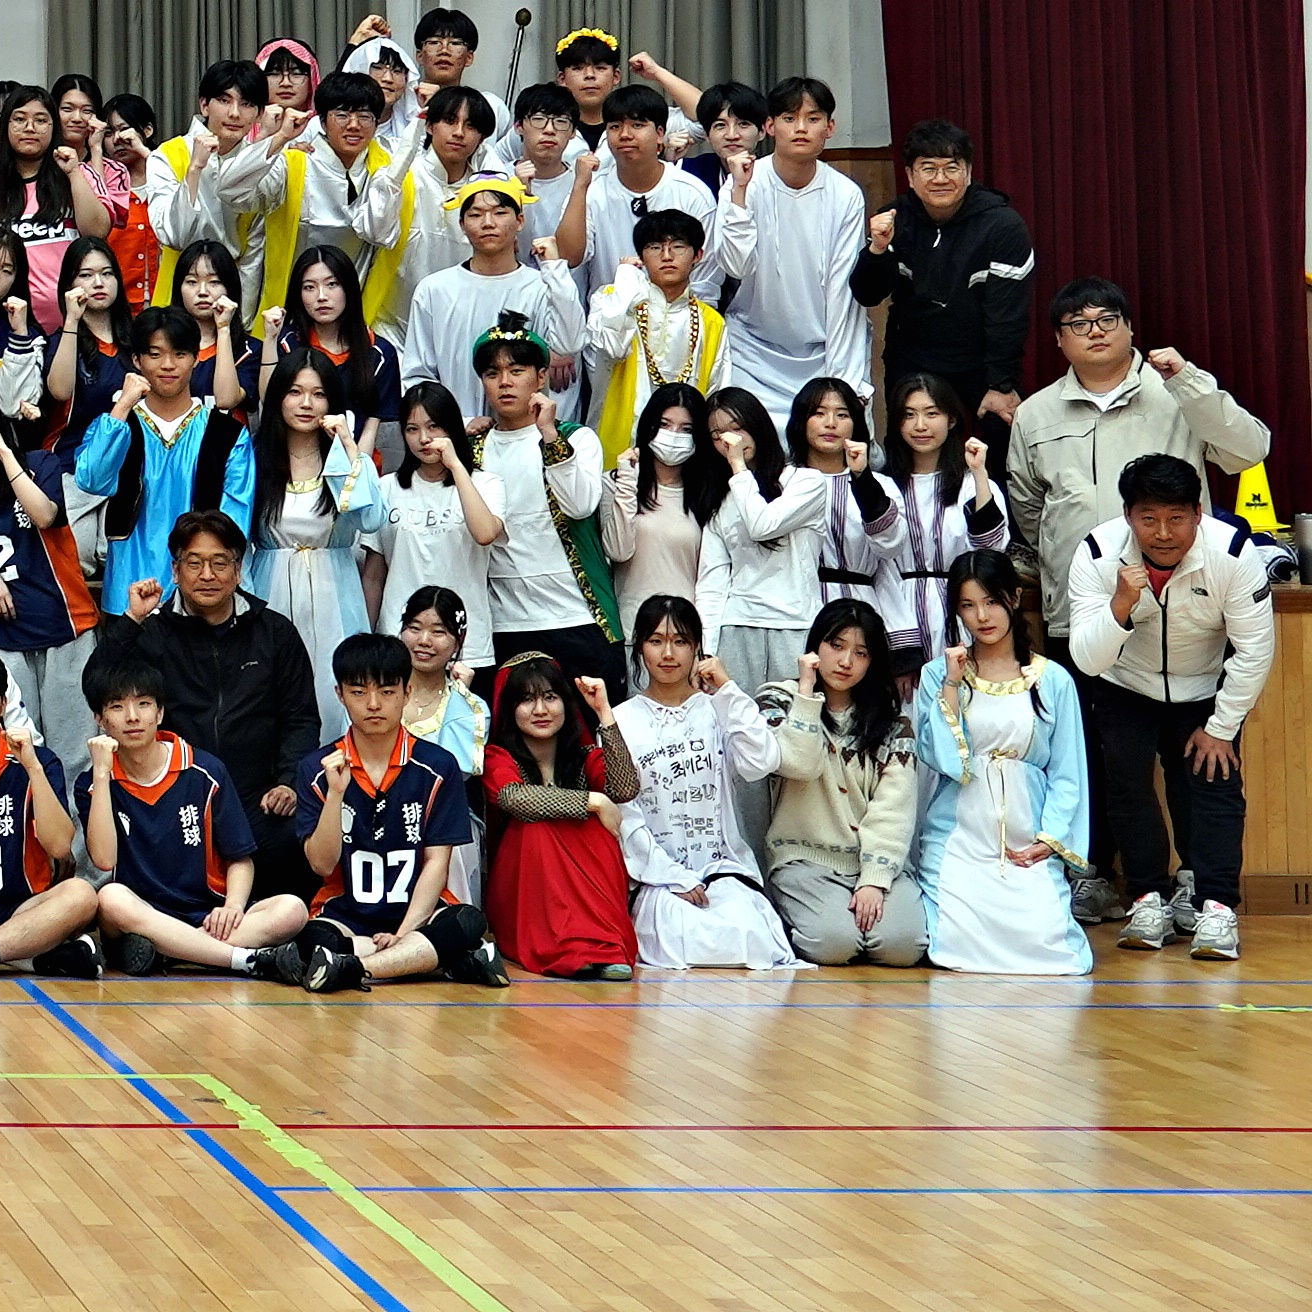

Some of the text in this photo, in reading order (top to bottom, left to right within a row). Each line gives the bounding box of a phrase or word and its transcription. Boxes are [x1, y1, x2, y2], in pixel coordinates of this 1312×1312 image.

[11, 221, 63, 238] eep
[388, 507, 466, 528] GUESS
[178, 804, 203, 847] 排球
[402, 801, 424, 844] 排球
[351, 848, 416, 904] 07
